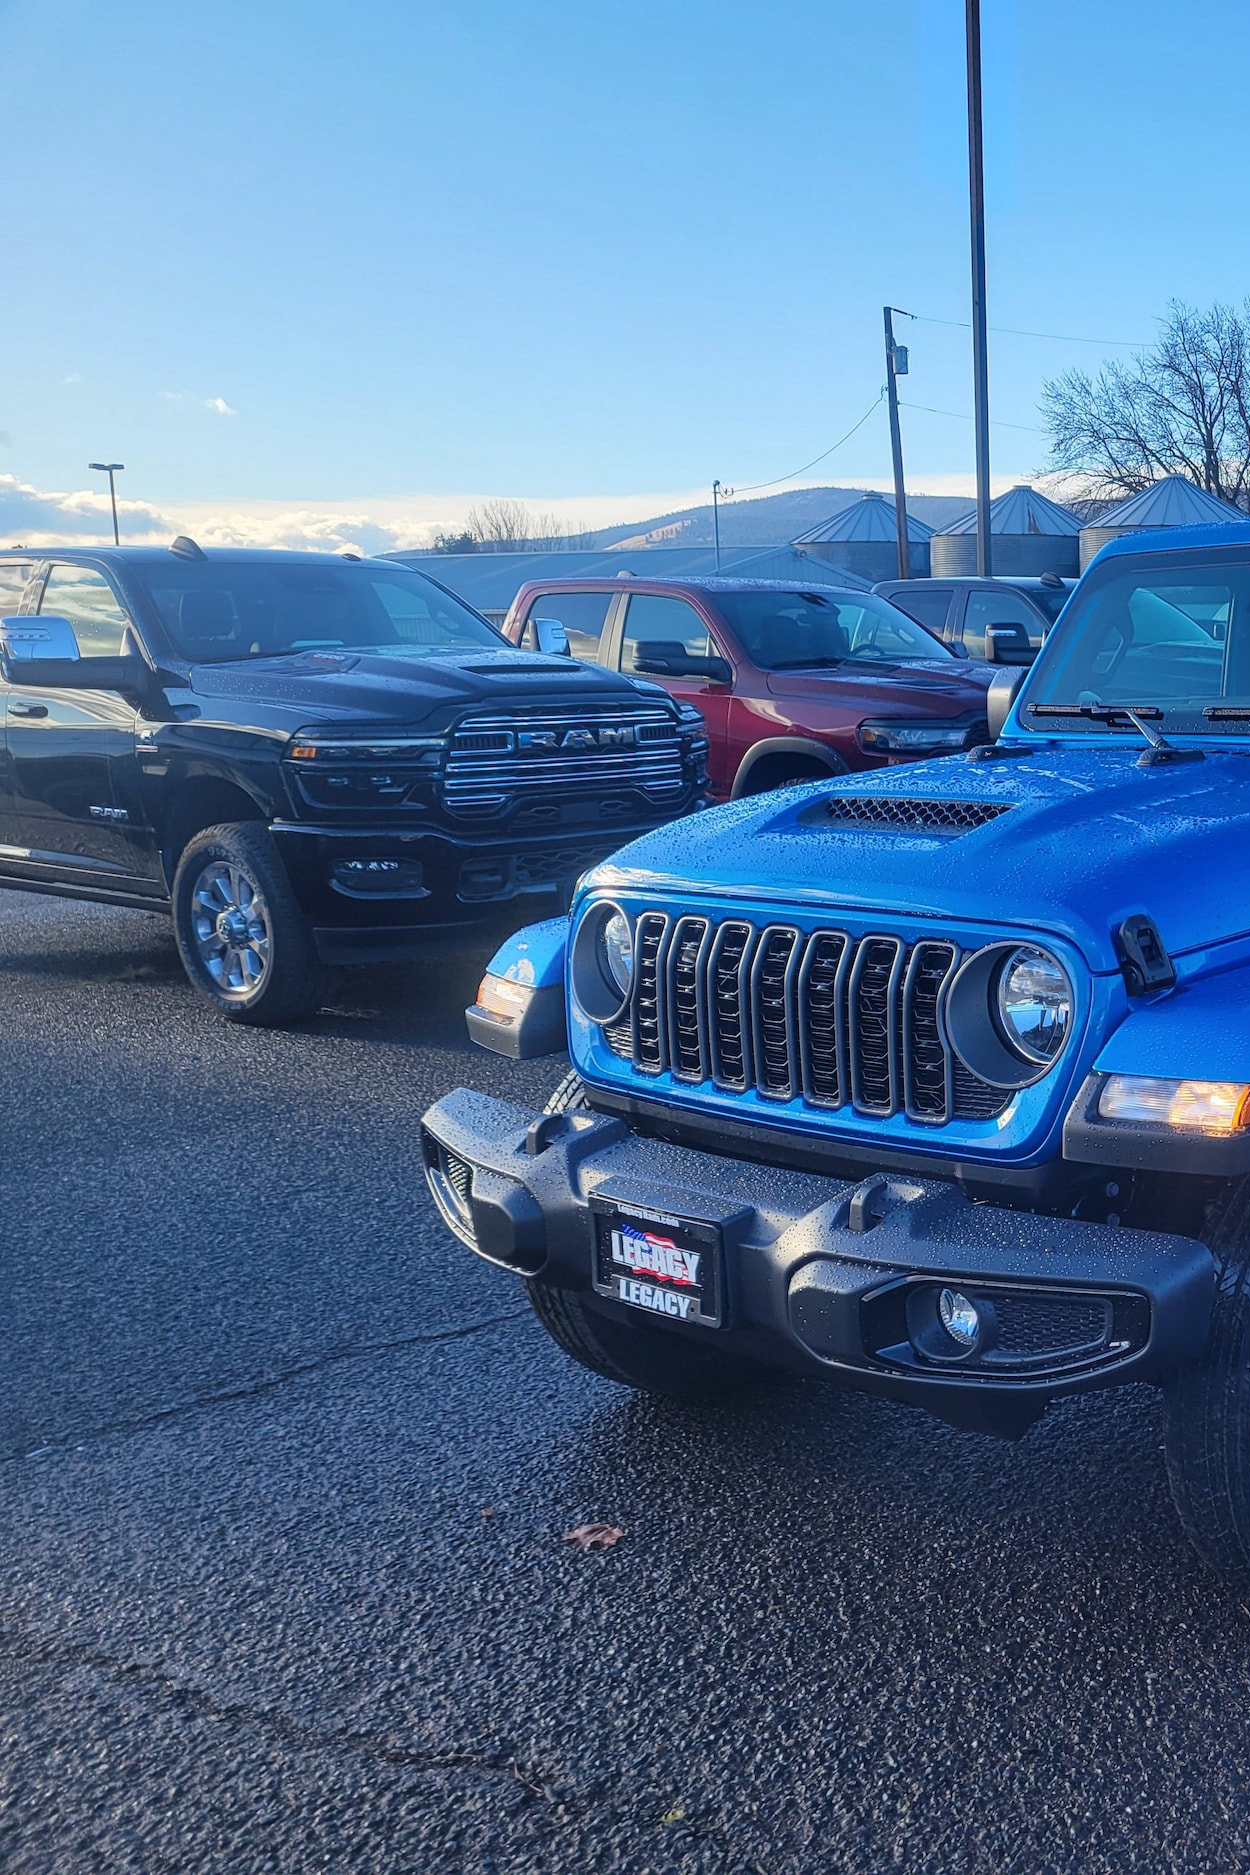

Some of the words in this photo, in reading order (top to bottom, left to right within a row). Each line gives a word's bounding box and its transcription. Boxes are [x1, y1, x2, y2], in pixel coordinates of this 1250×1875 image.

[518, 726, 635, 748] RAM
[89, 805, 128, 819] RAM
[611, 1230, 701, 1283] LEGACY
[619, 1279, 691, 1318] LEGACY
